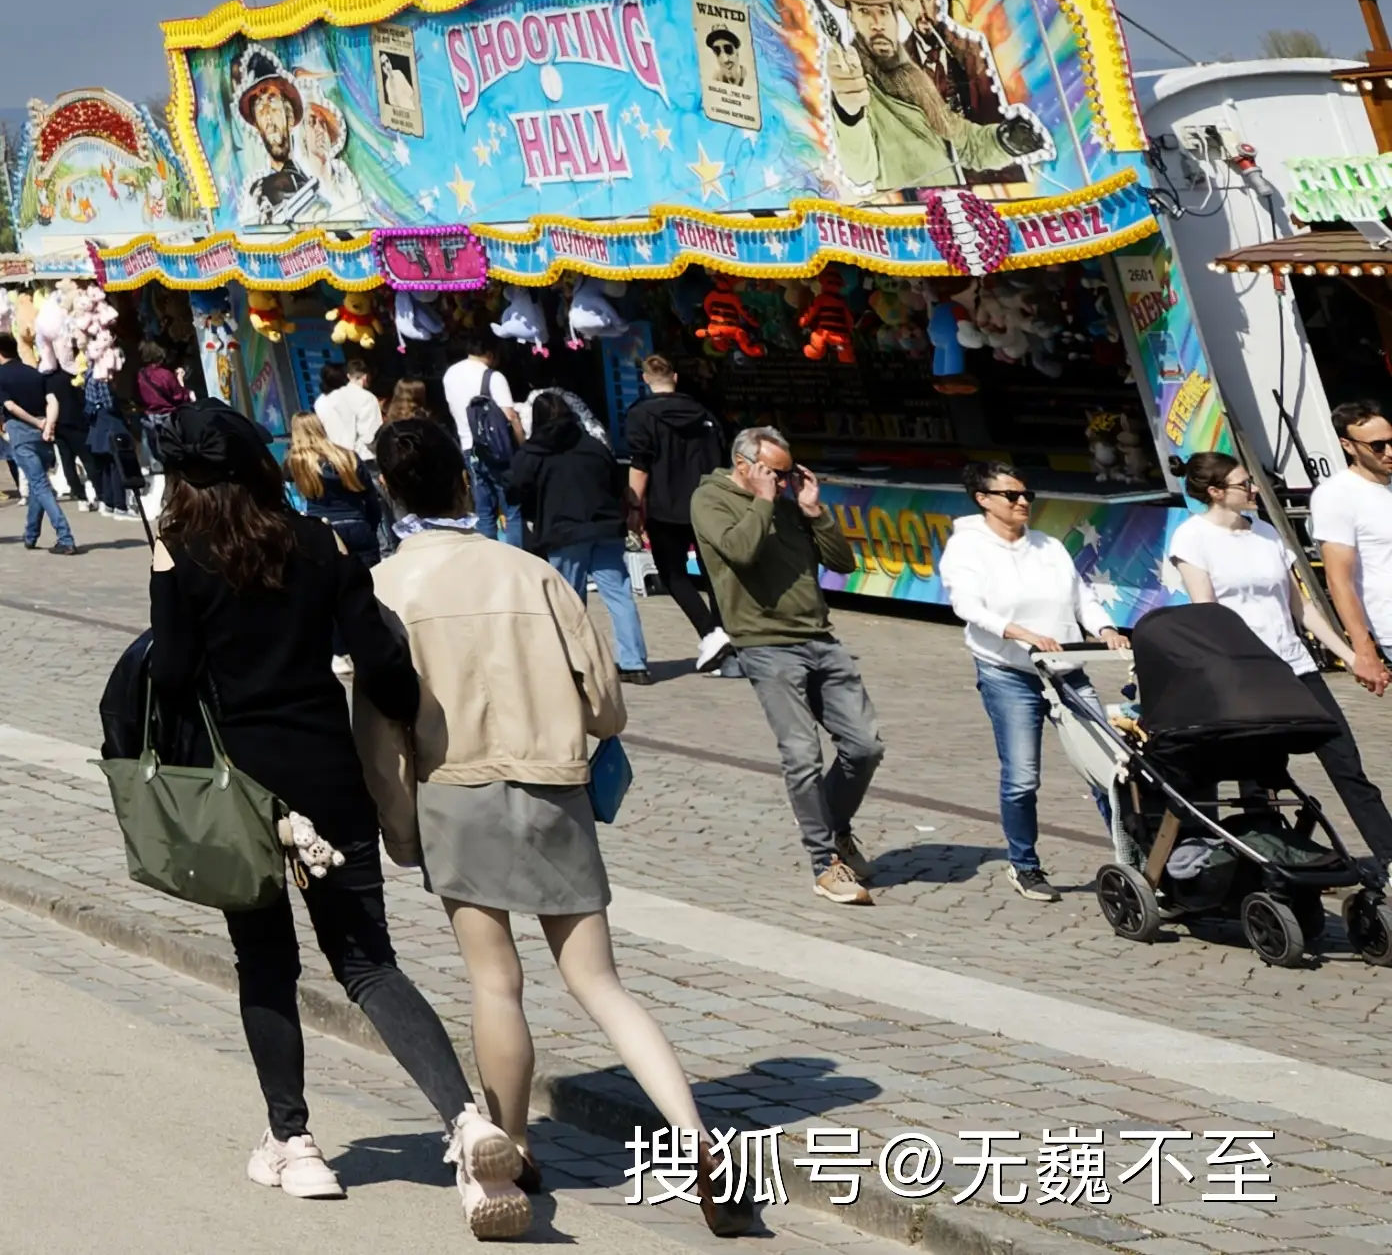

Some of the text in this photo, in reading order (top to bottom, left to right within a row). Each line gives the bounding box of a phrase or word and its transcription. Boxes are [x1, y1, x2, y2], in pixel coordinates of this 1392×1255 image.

[696, 1, 746, 23] WANTED
[512, 106, 631, 183] HALL
[551, 230, 609, 262] OLYMPIA
[817, 216, 890, 256] STERNE
[1018, 206, 1109, 249] HERZ
[1128, 268, 1155, 282] 2601
[833, 503, 954, 581] HOOT
